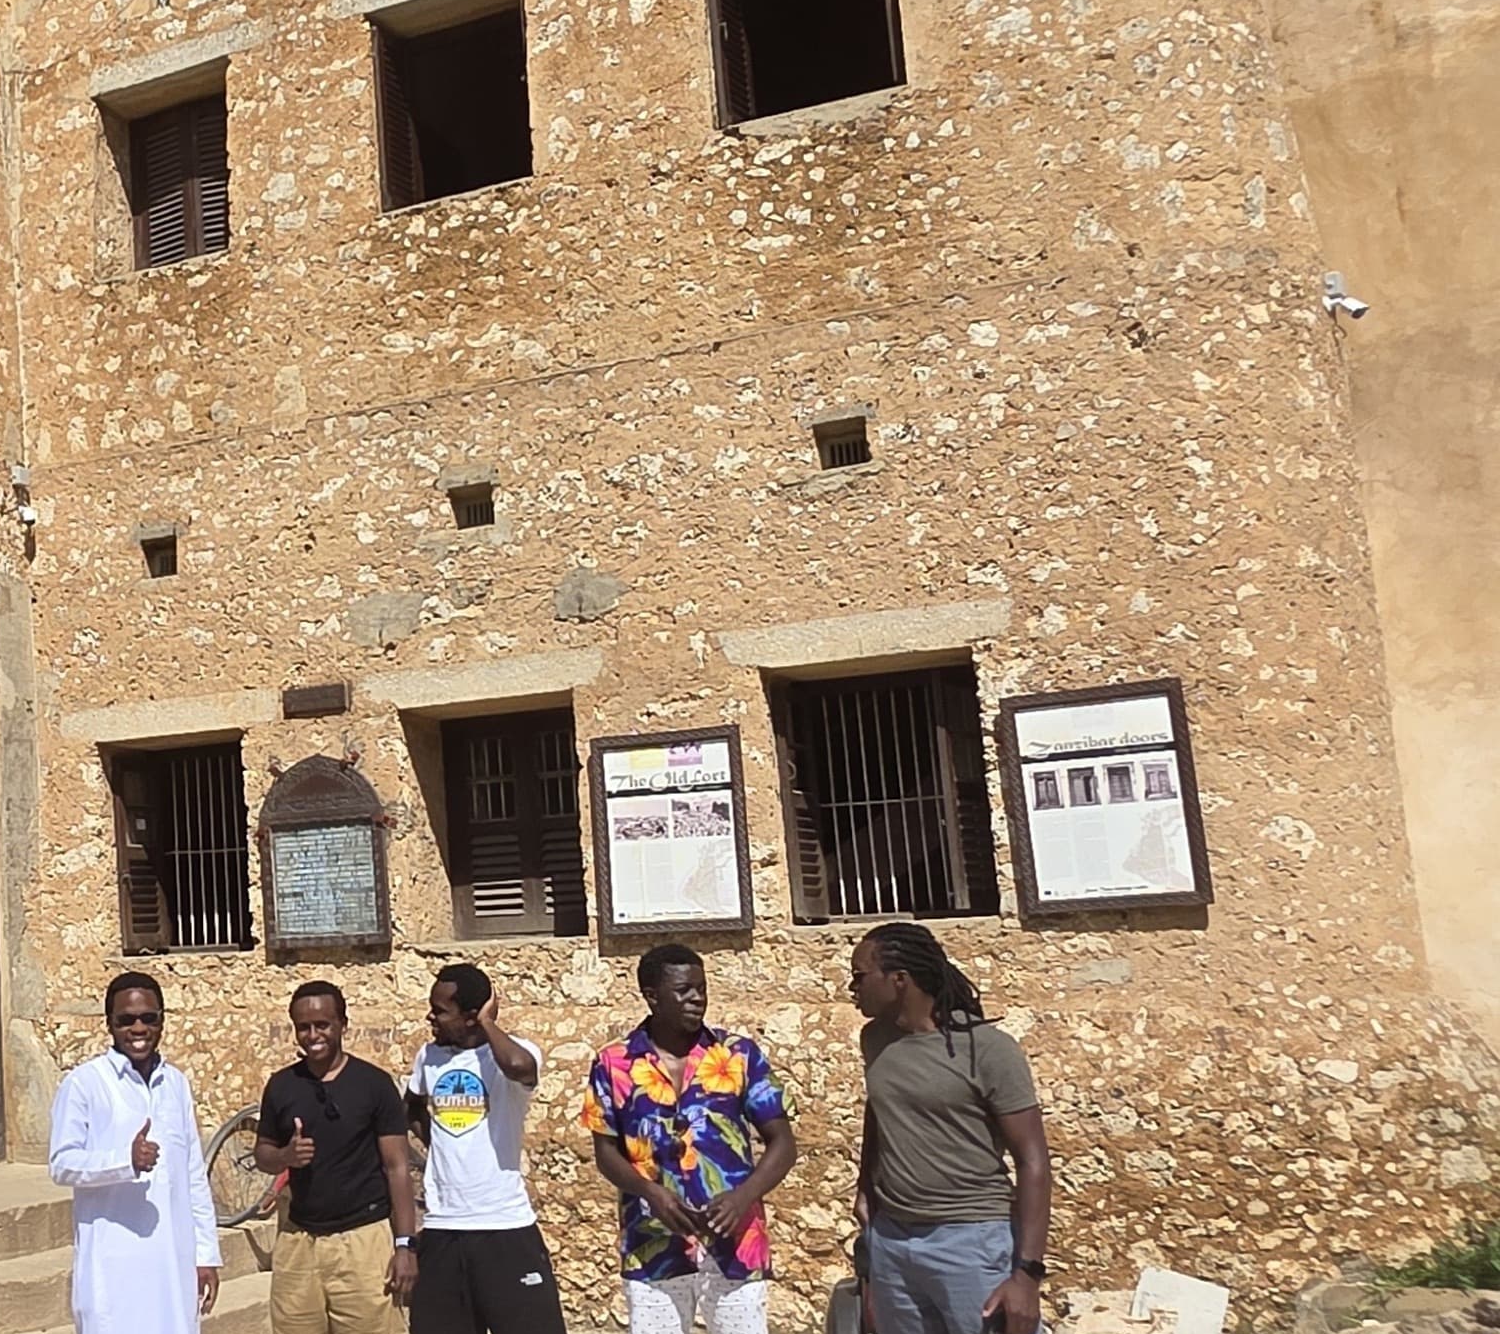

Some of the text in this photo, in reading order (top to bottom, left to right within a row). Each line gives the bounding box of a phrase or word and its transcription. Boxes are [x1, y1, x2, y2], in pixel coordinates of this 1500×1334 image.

[1027, 735, 1116, 759] Zanzibar
[1119, 732, 1169, 744] doors
[610, 769, 726, 793] The Old Fort
[432, 1095, 466, 1107] OUTH
